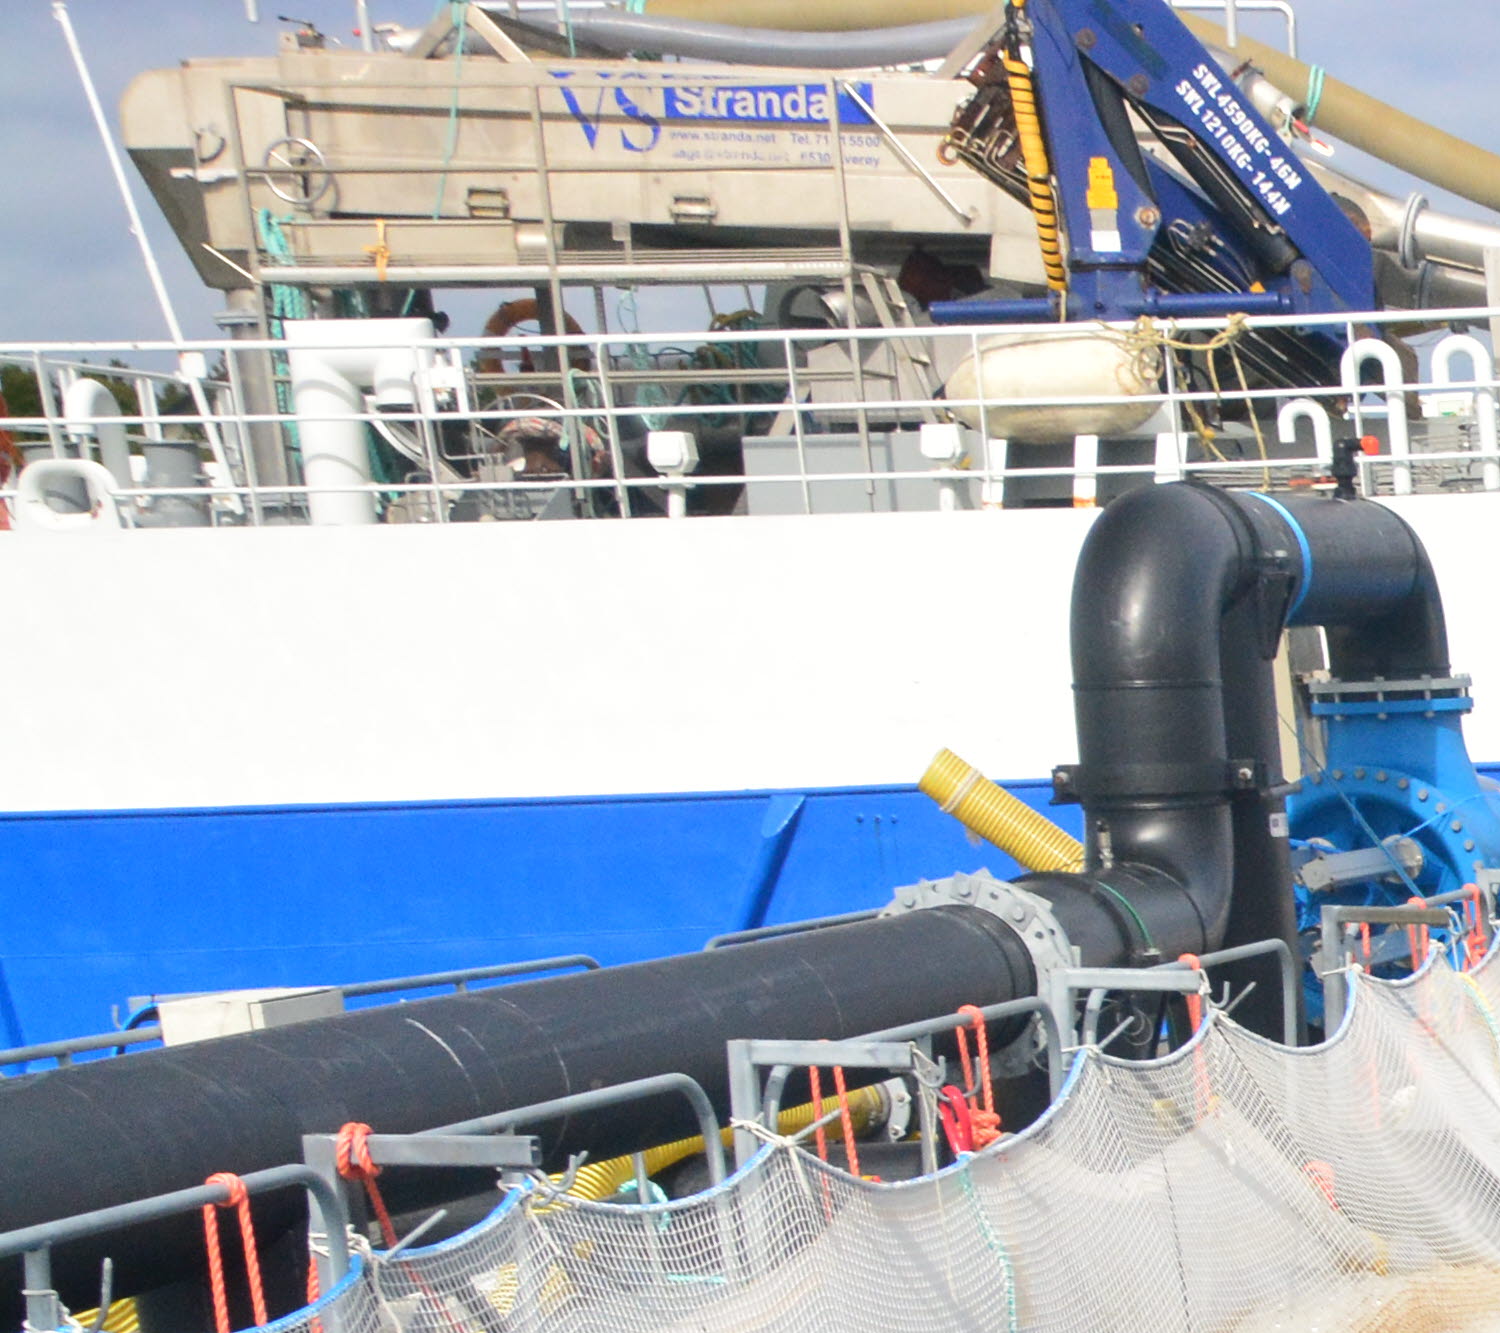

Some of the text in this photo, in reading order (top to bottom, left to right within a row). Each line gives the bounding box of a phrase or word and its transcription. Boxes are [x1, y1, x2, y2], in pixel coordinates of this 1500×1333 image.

[1175, 79, 1205, 116] SWL
[1192, 63, 1222, 99] SWL
[548, 71, 831, 152] VS Stranda
[670, 131, 776, 145] www.stranda.net
[845, 155, 880, 167] verøy
